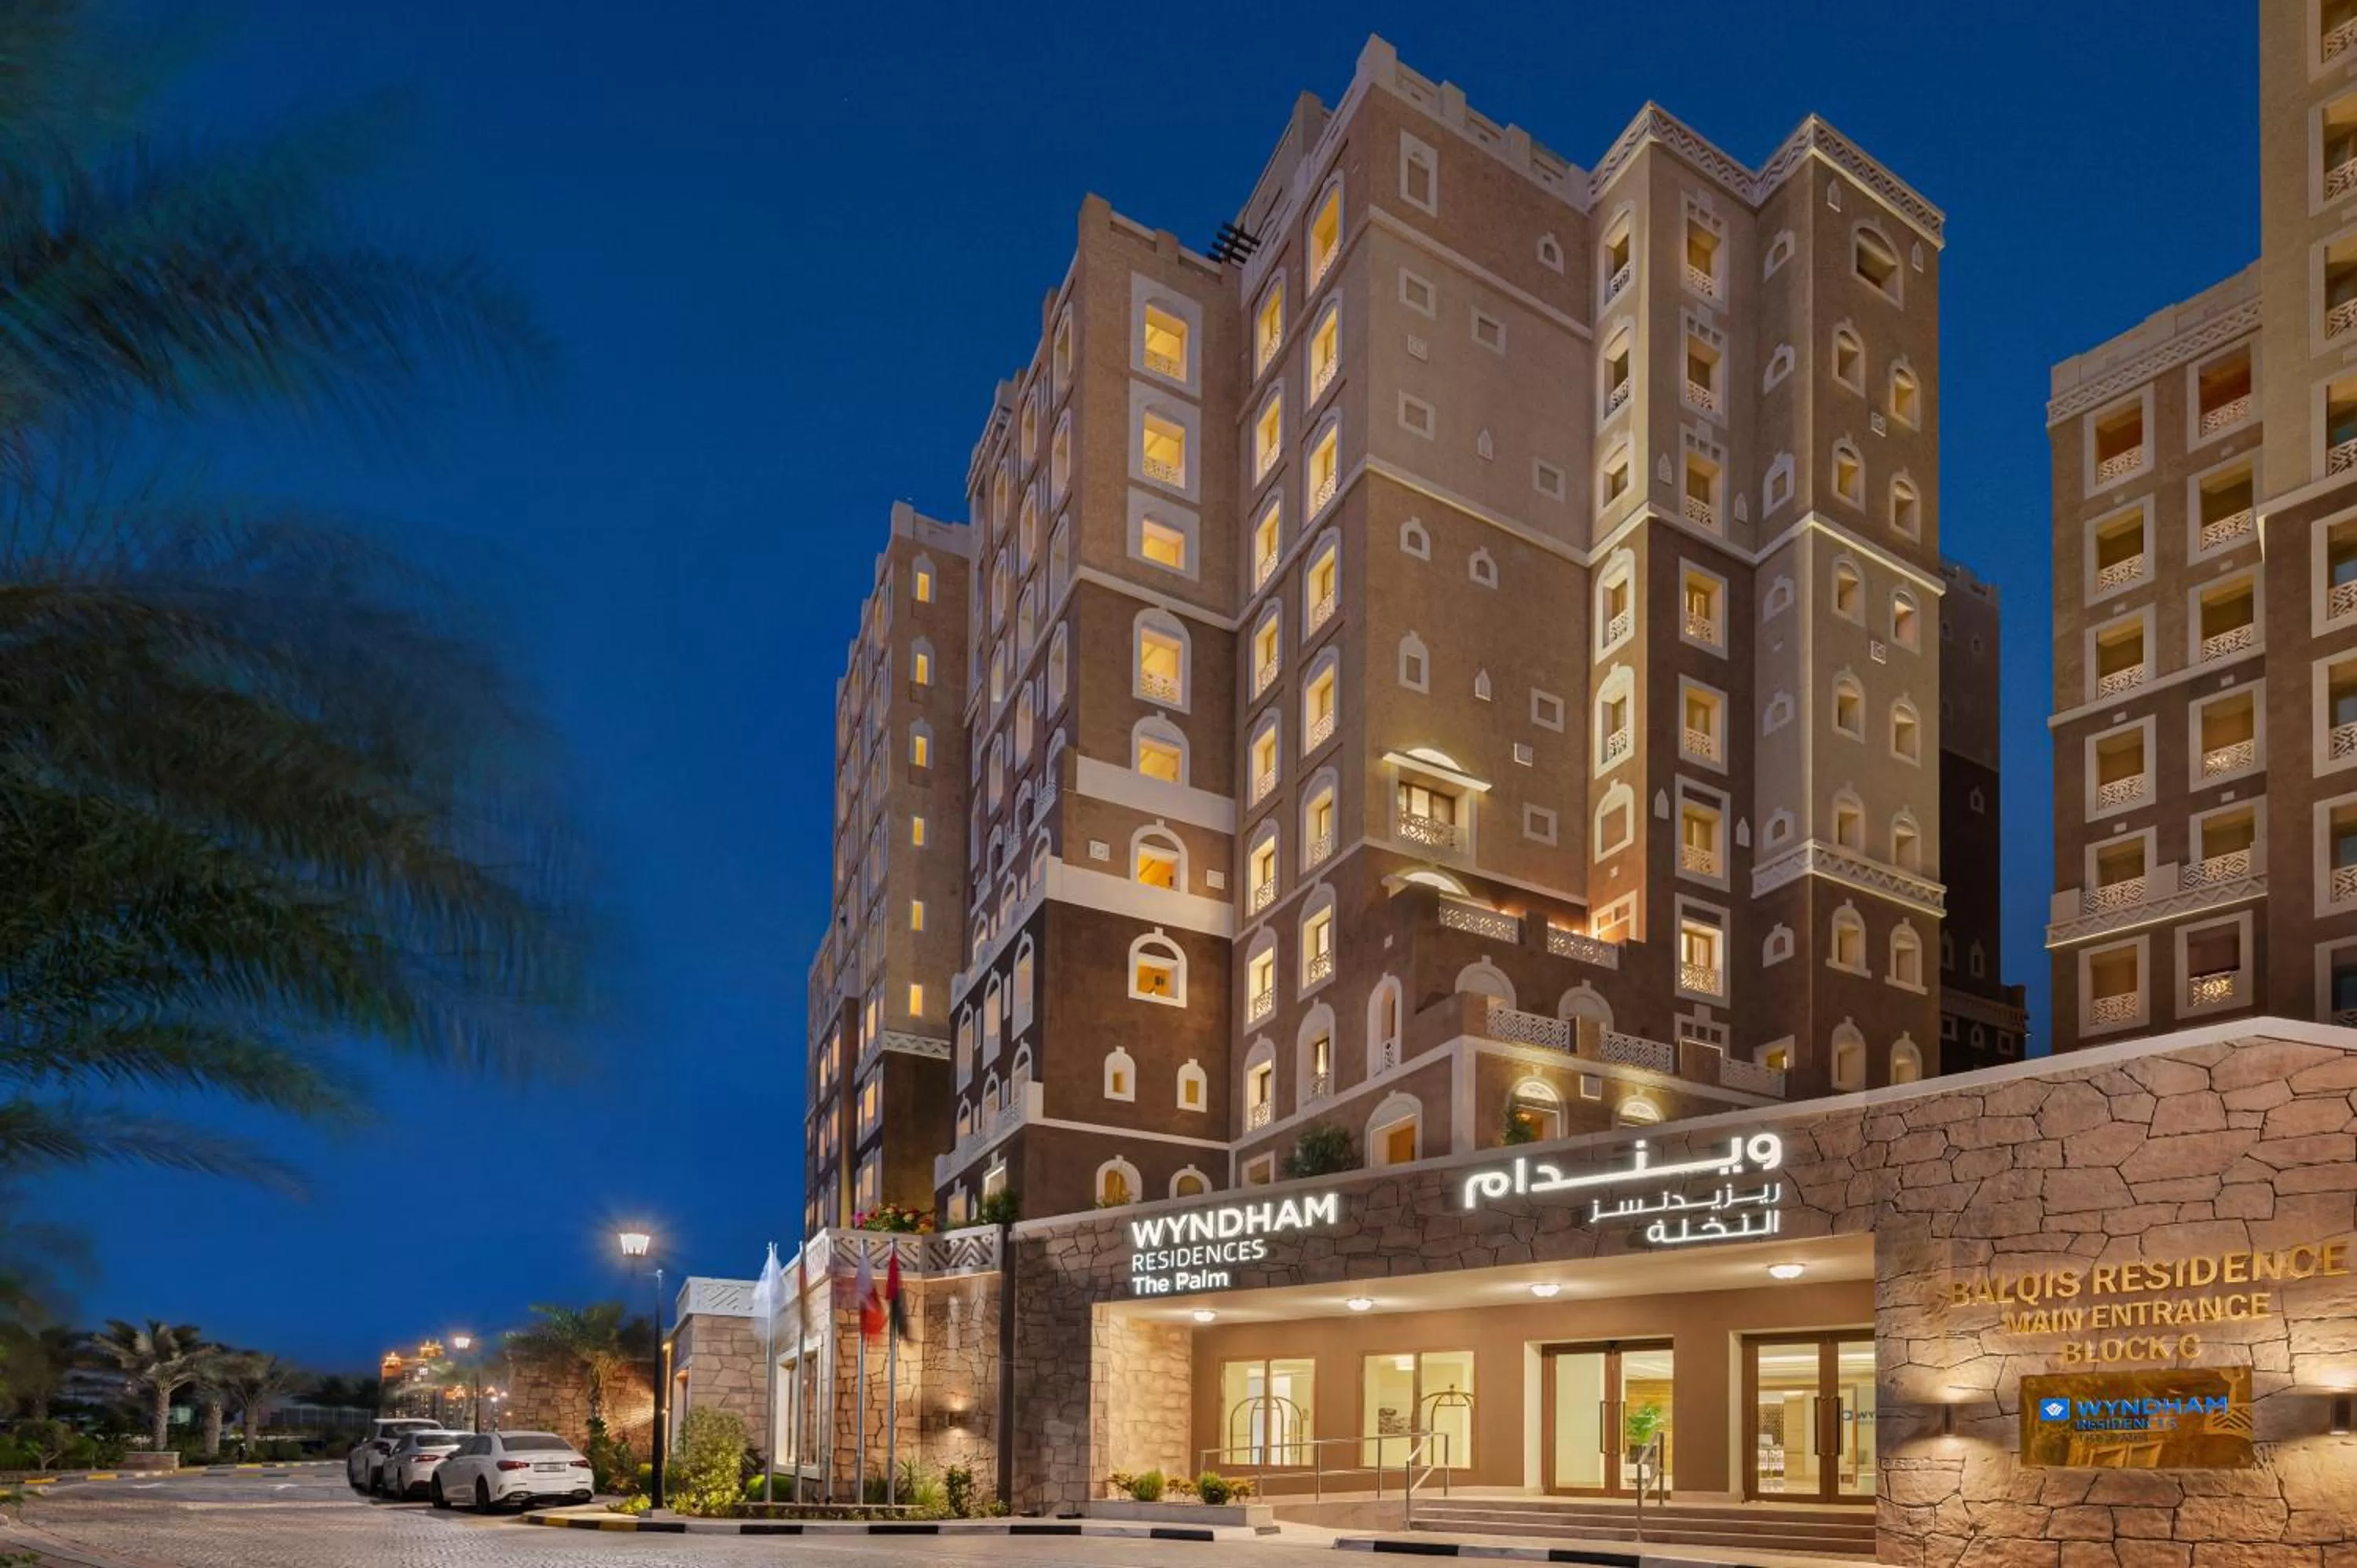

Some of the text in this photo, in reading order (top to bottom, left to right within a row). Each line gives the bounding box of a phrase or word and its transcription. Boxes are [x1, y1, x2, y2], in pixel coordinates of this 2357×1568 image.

[1464, 1133, 1783, 1209] ويندام
[1131, 1192, 1338, 1249] WYNDHAM
[1132, 1239, 1266, 1273] RESIDENCES
[1949, 1239, 2352, 1308] BALQIS RESIDENCE
[1132, 1269, 1229, 1295] The Palm
[2003, 1292, 2272, 1335] MAIN ENTRANCE
[2062, 1335, 2171, 1365] BLOCK
[2077, 1396, 2228, 1416] WYNDHAM
